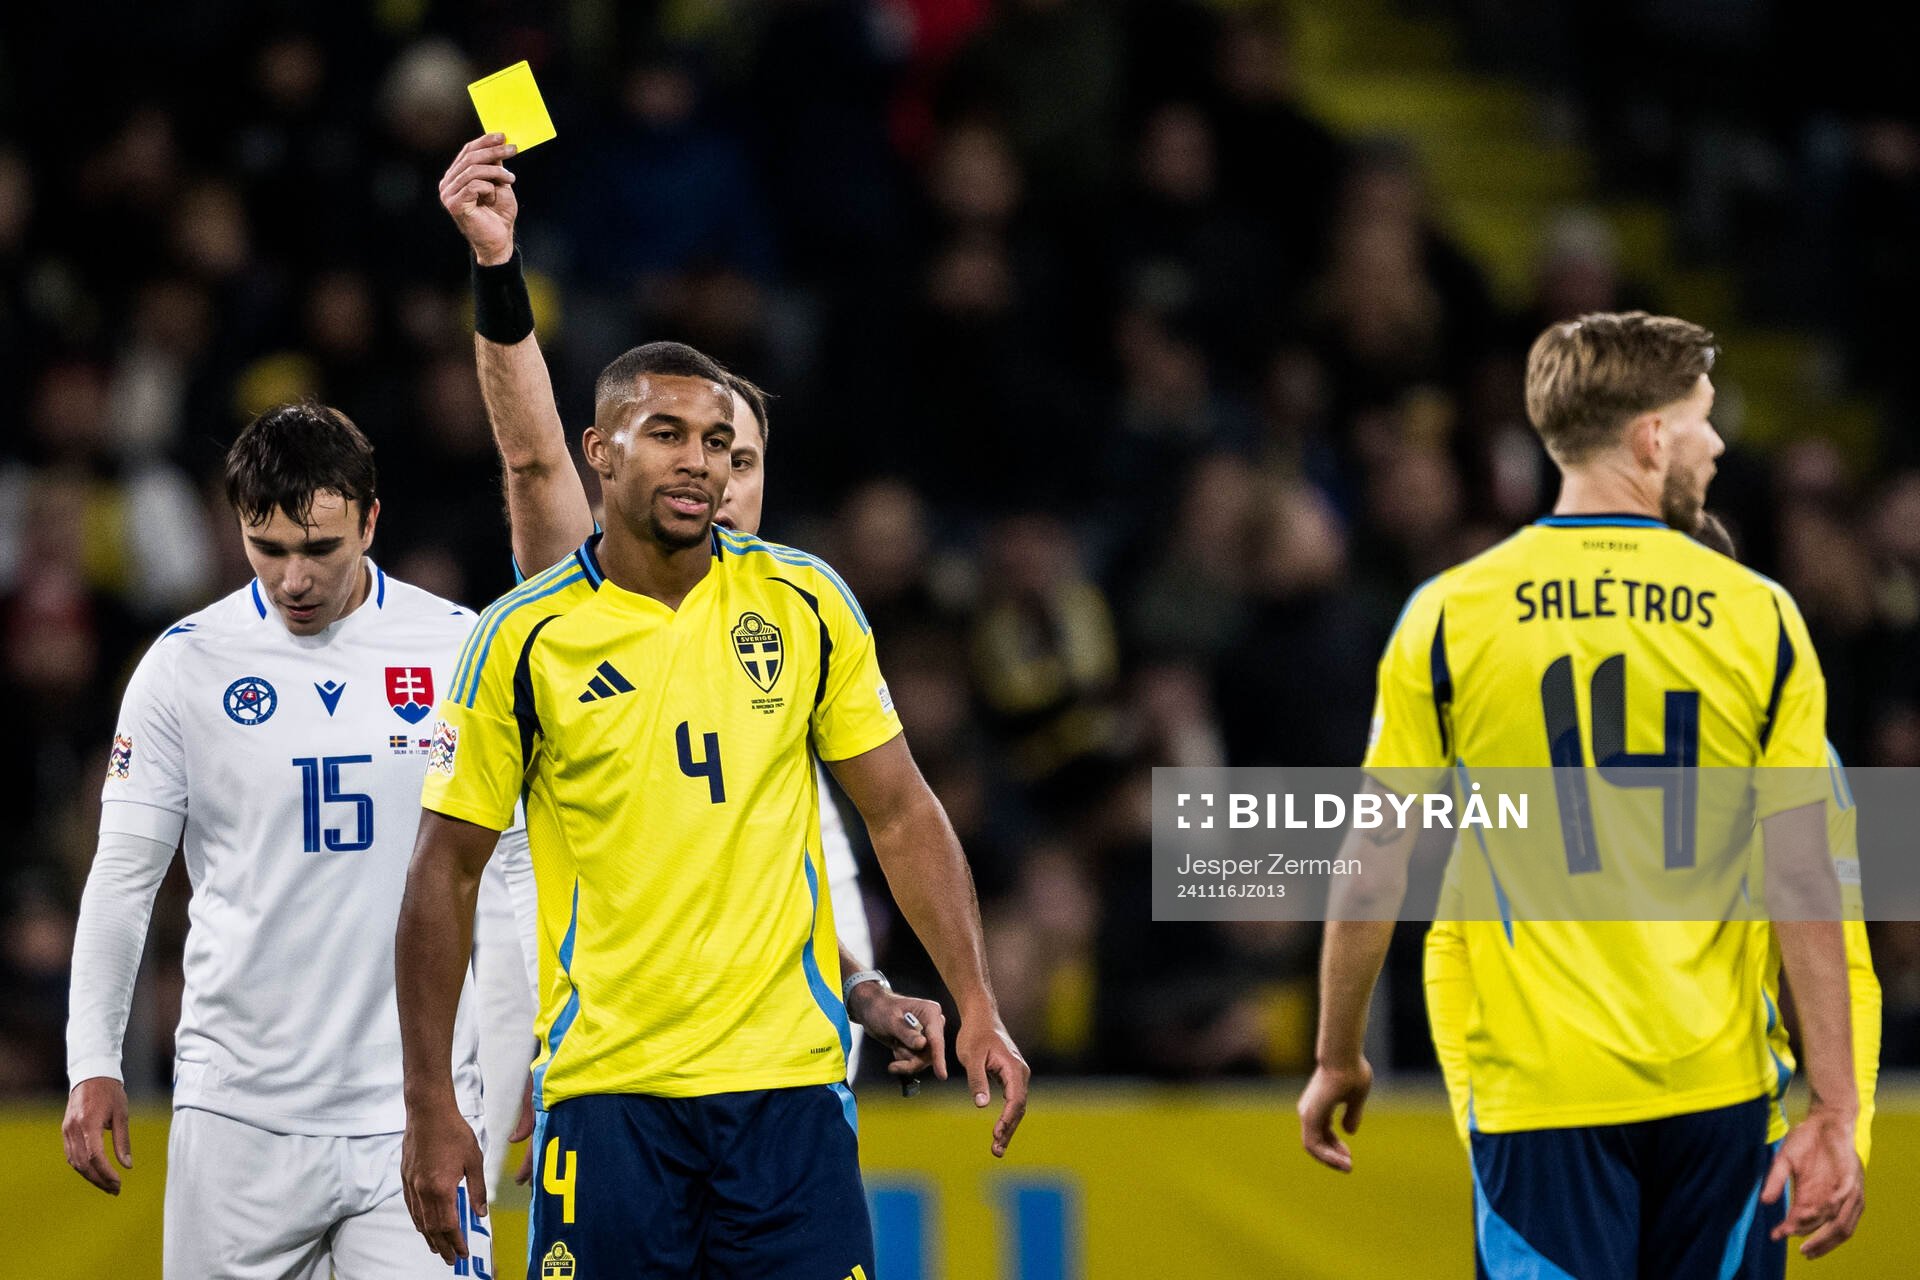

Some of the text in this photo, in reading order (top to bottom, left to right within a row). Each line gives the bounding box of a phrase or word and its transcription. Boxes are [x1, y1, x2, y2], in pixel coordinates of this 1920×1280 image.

[740, 634, 773, 643] SVERIGE
[1516, 569, 1717, 629] SALÉTROS
[292, 754, 374, 852] 15
[675, 720, 726, 804] 4
[1541, 653, 1700, 876] 14
[543, 1136, 577, 1224] 4
